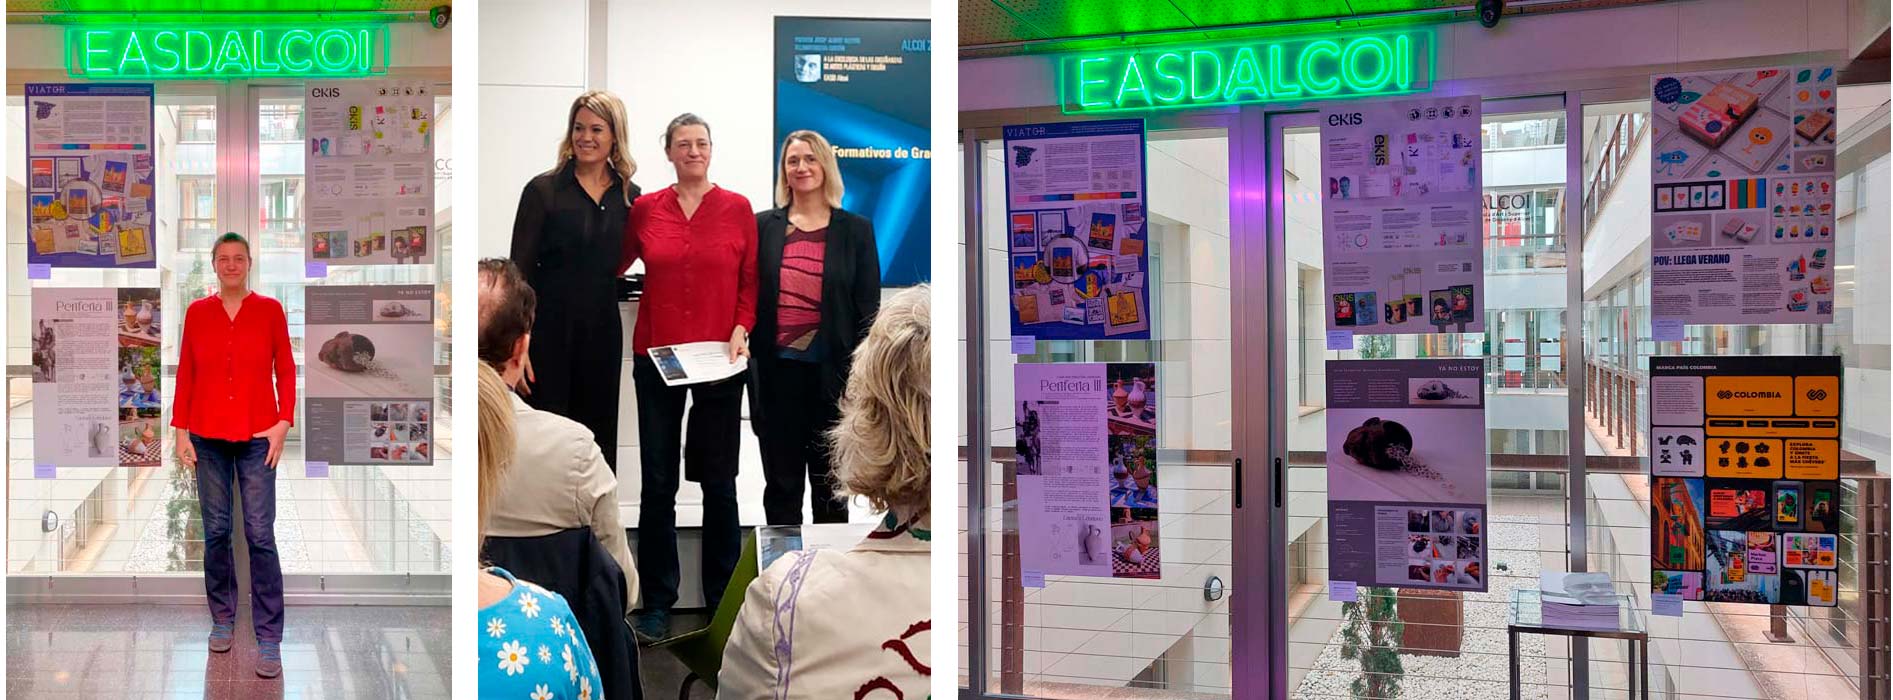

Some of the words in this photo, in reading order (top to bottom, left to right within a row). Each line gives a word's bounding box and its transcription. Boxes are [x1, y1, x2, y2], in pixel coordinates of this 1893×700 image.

[86, 30, 370, 72] EASDALCOI
[902, 39, 926, 51] ALCOI
[1080, 34, 1410, 107] EASDALCOI
[28, 86, 65, 94] VIATOR
[1007, 127, 1046, 137] VIATOR
[832, 146, 892, 158] Formativos
[894, 147, 909, 159] de
[1653, 256, 1672, 266] POV:
[1674, 255, 1697, 265] LLEGA
[1698, 254, 1730, 265] VERANO
[1734, 391, 1782, 399] COLOMBIA
